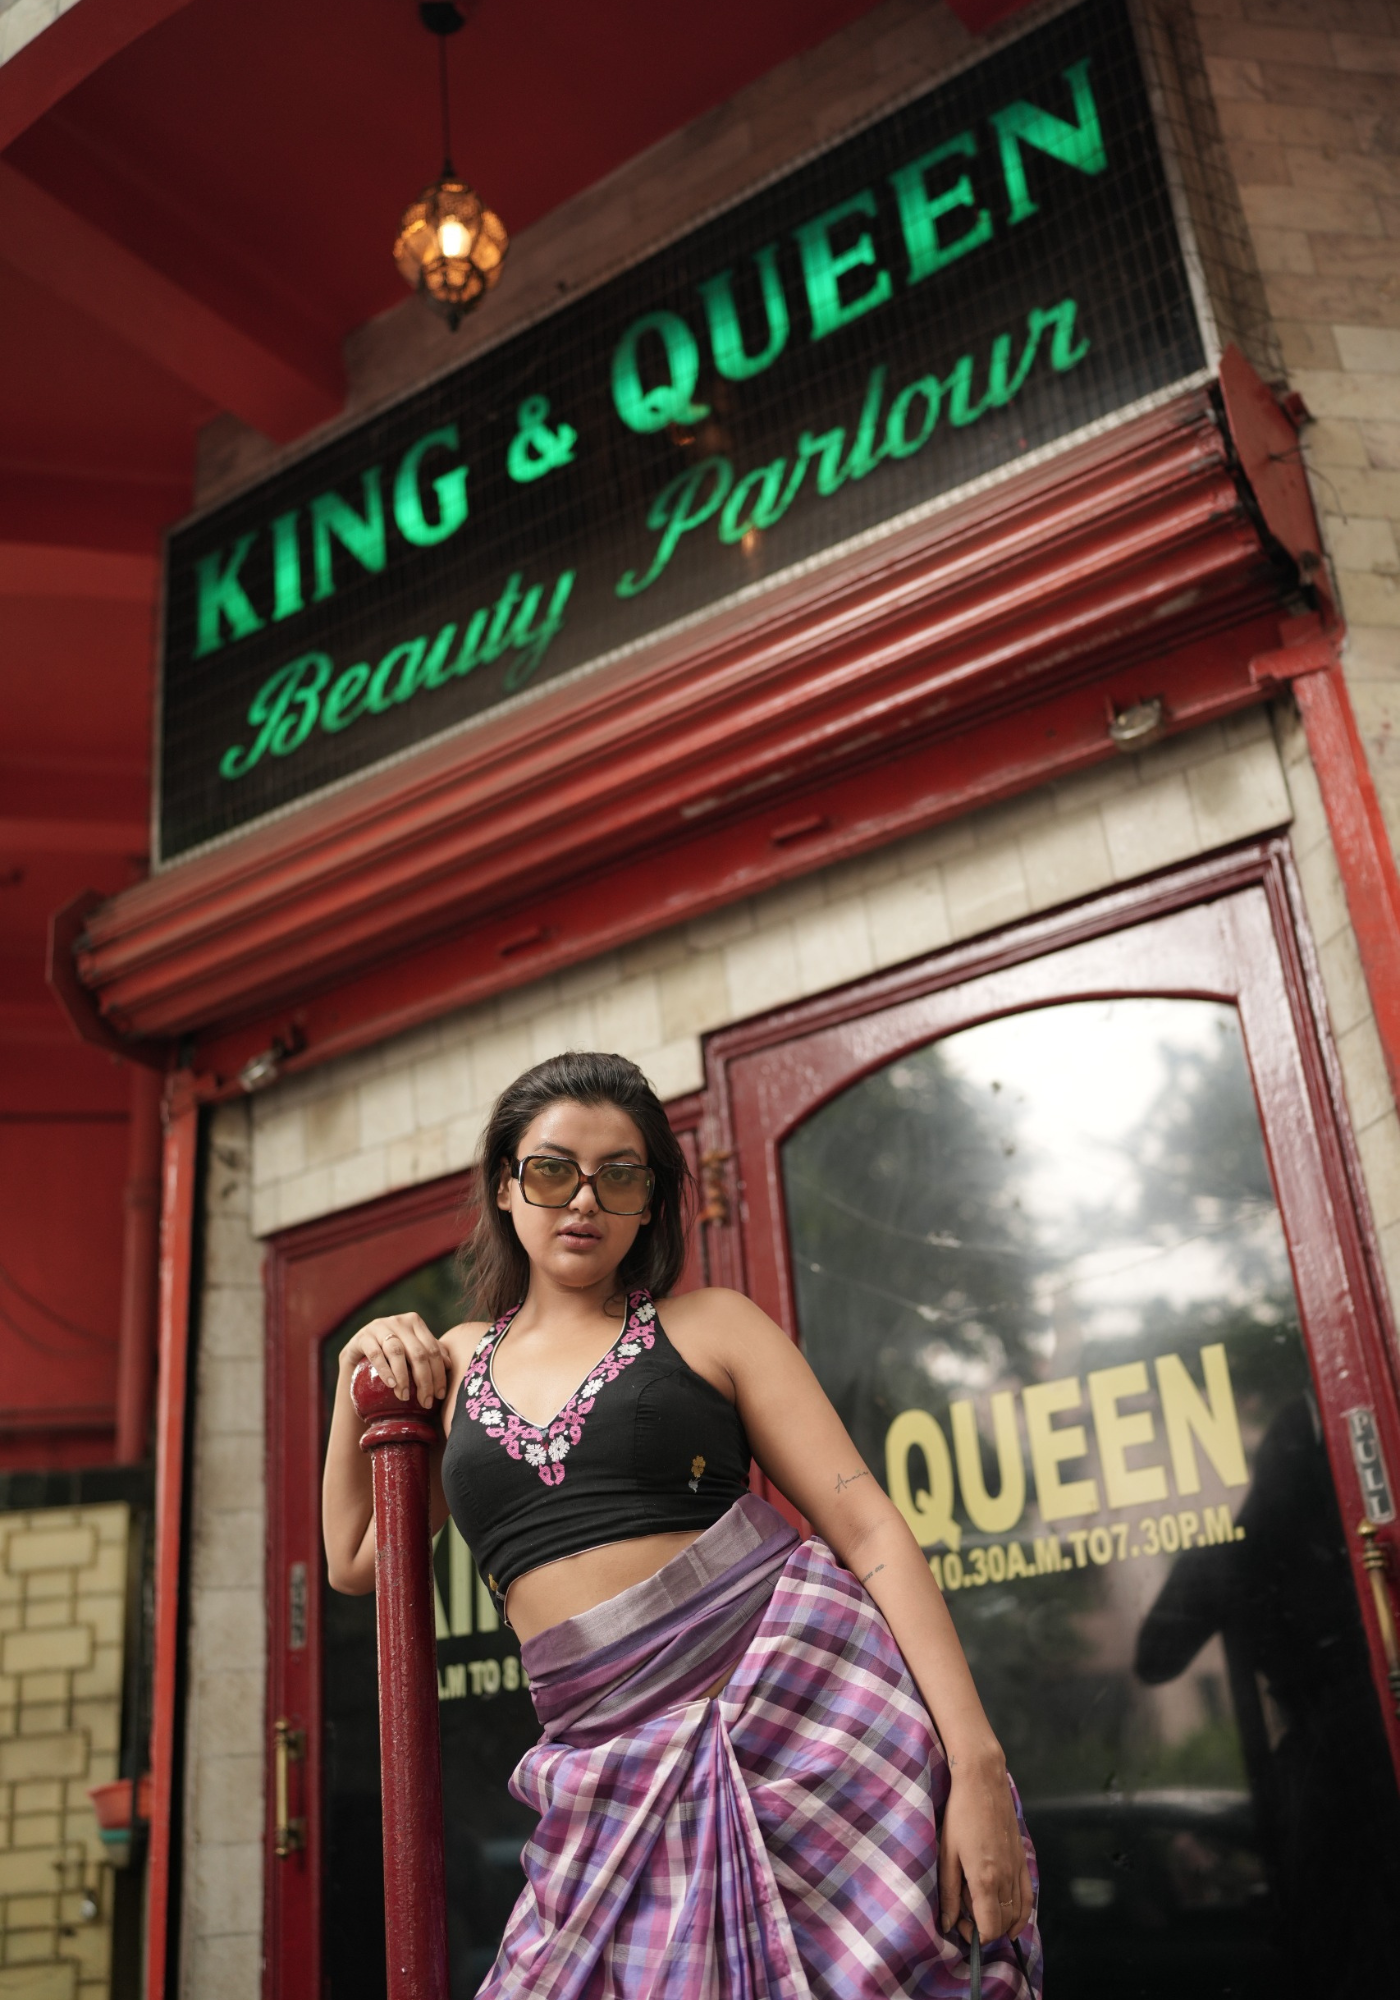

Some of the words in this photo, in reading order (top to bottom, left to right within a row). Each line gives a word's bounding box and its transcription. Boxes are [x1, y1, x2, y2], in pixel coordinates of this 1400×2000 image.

[193, 423, 469, 658] KING
[505, 394, 578, 484] &
[611, 57, 1107, 434] QUEEN
[218, 568, 576, 781] Beauty
[616, 299, 1092, 598] Parlour
[885, 1342, 1249, 1552] QUEEN
[1353, 1411, 1391, 1519] PULL
[467, 1658, 500, 1695] TO
[502, 1655, 519, 1692] 8
